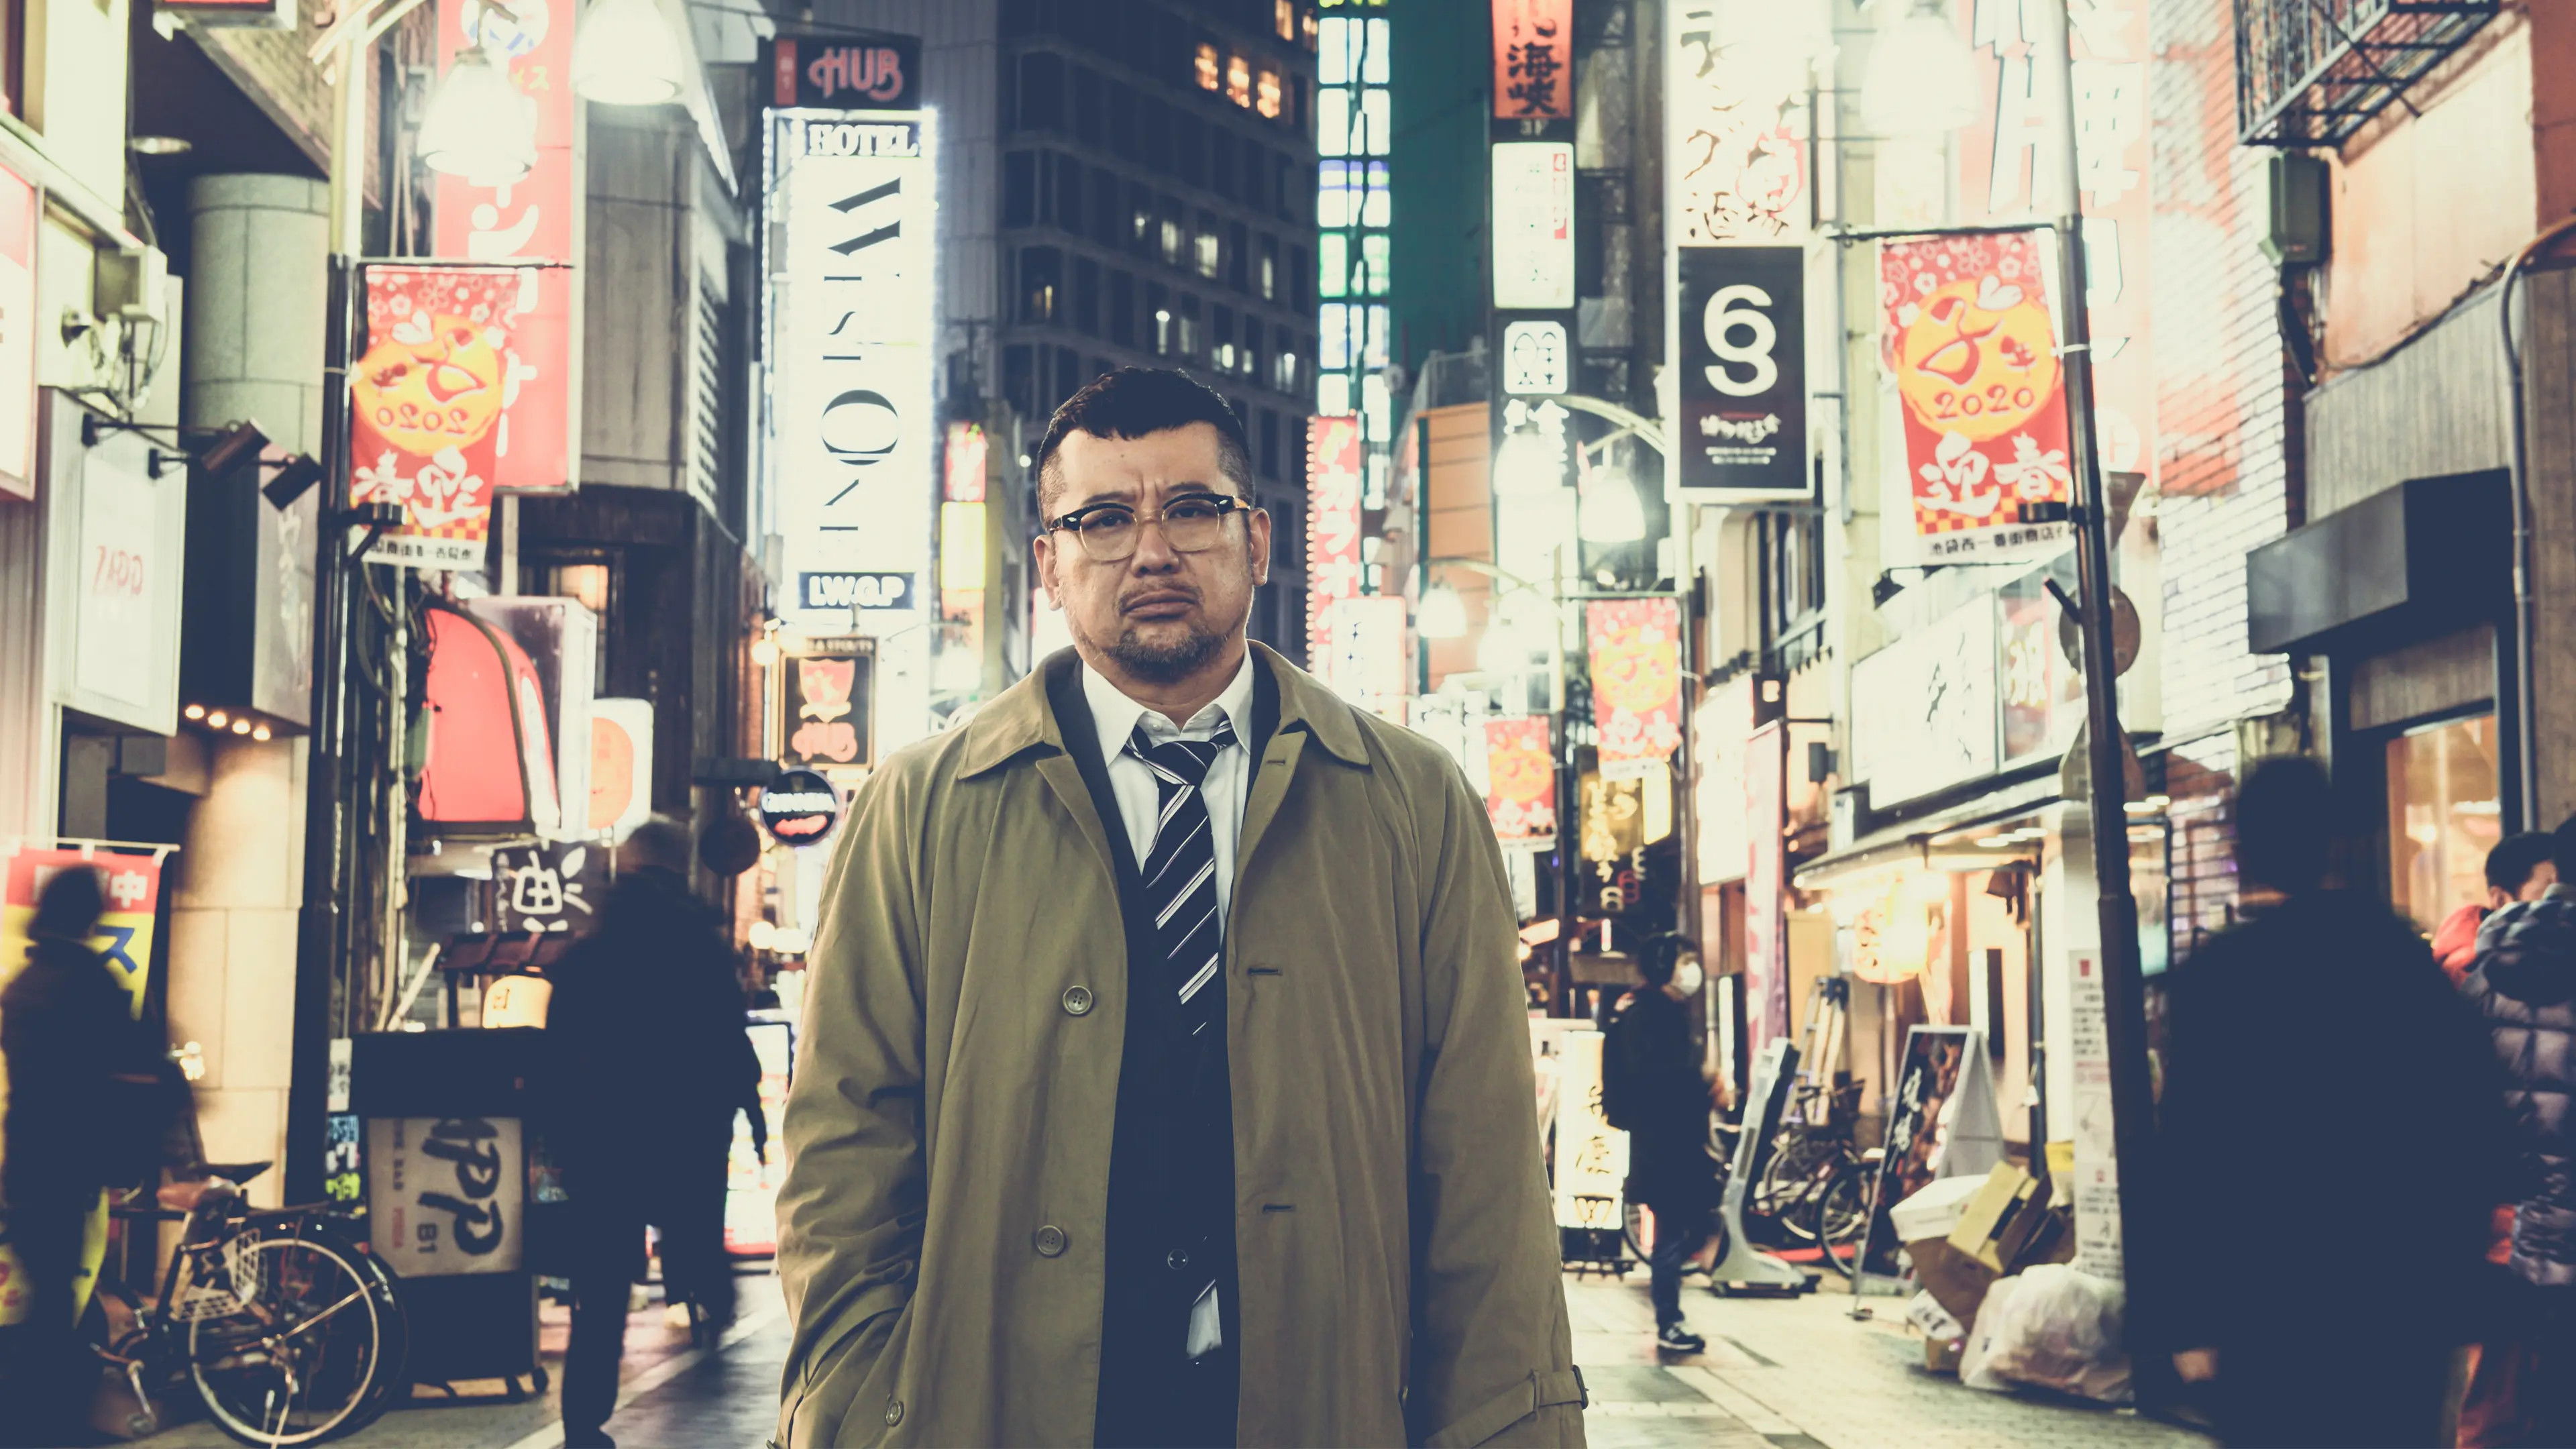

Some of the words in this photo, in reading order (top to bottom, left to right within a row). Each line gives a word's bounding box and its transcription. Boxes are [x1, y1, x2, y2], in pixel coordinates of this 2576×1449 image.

[808, 47, 904, 101] HUB
[808, 124, 919, 157] HOTEL
[1933, 383, 2035, 421] 2020
[1917, 431, 2068, 519] 迎春
